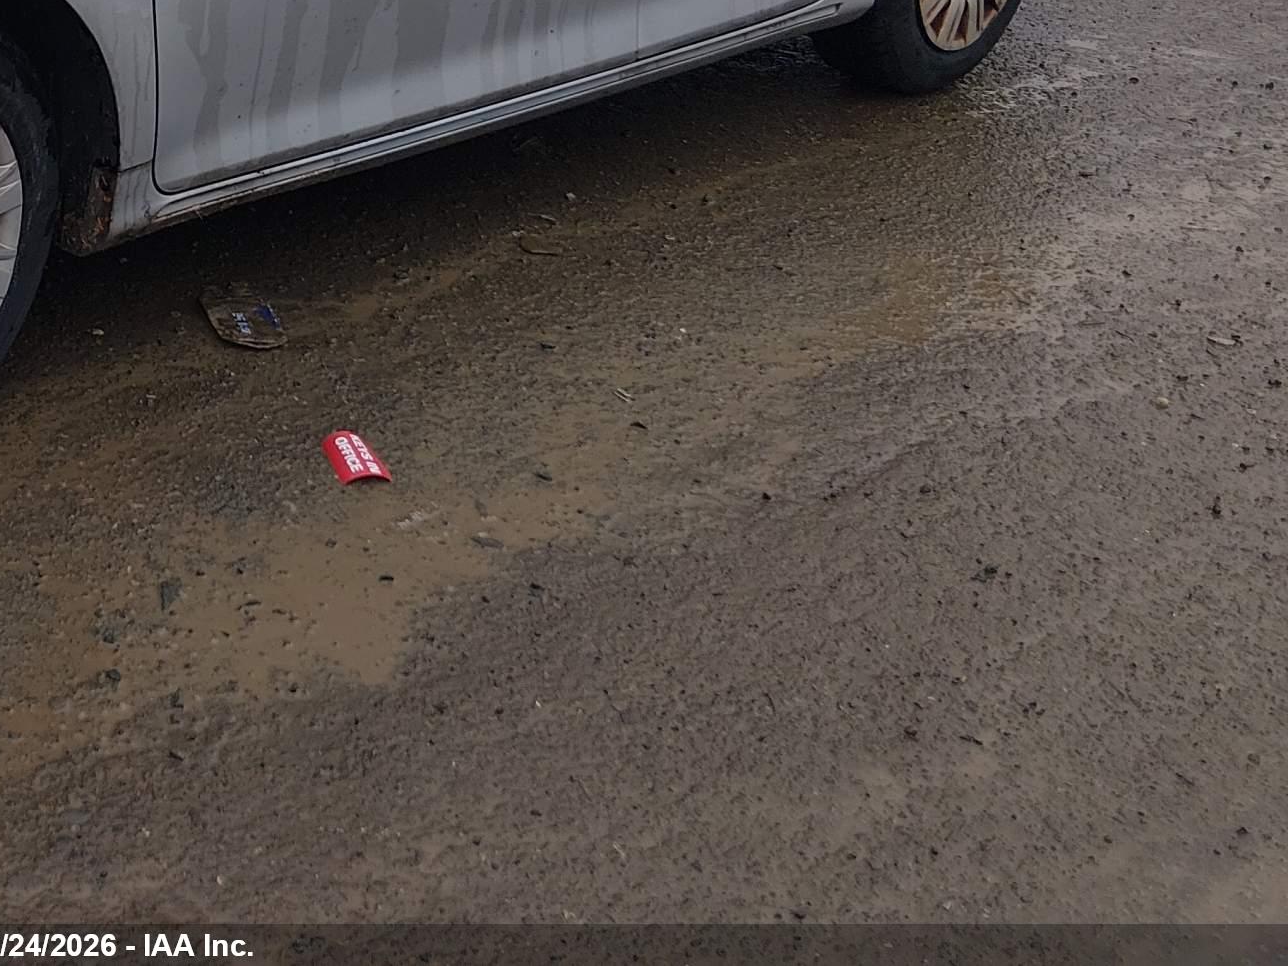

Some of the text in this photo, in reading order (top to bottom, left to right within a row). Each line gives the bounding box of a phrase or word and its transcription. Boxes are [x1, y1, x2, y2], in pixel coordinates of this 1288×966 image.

[334, 436, 364, 474] OFFICE
[349, 433, 382, 475] KEYS IN
